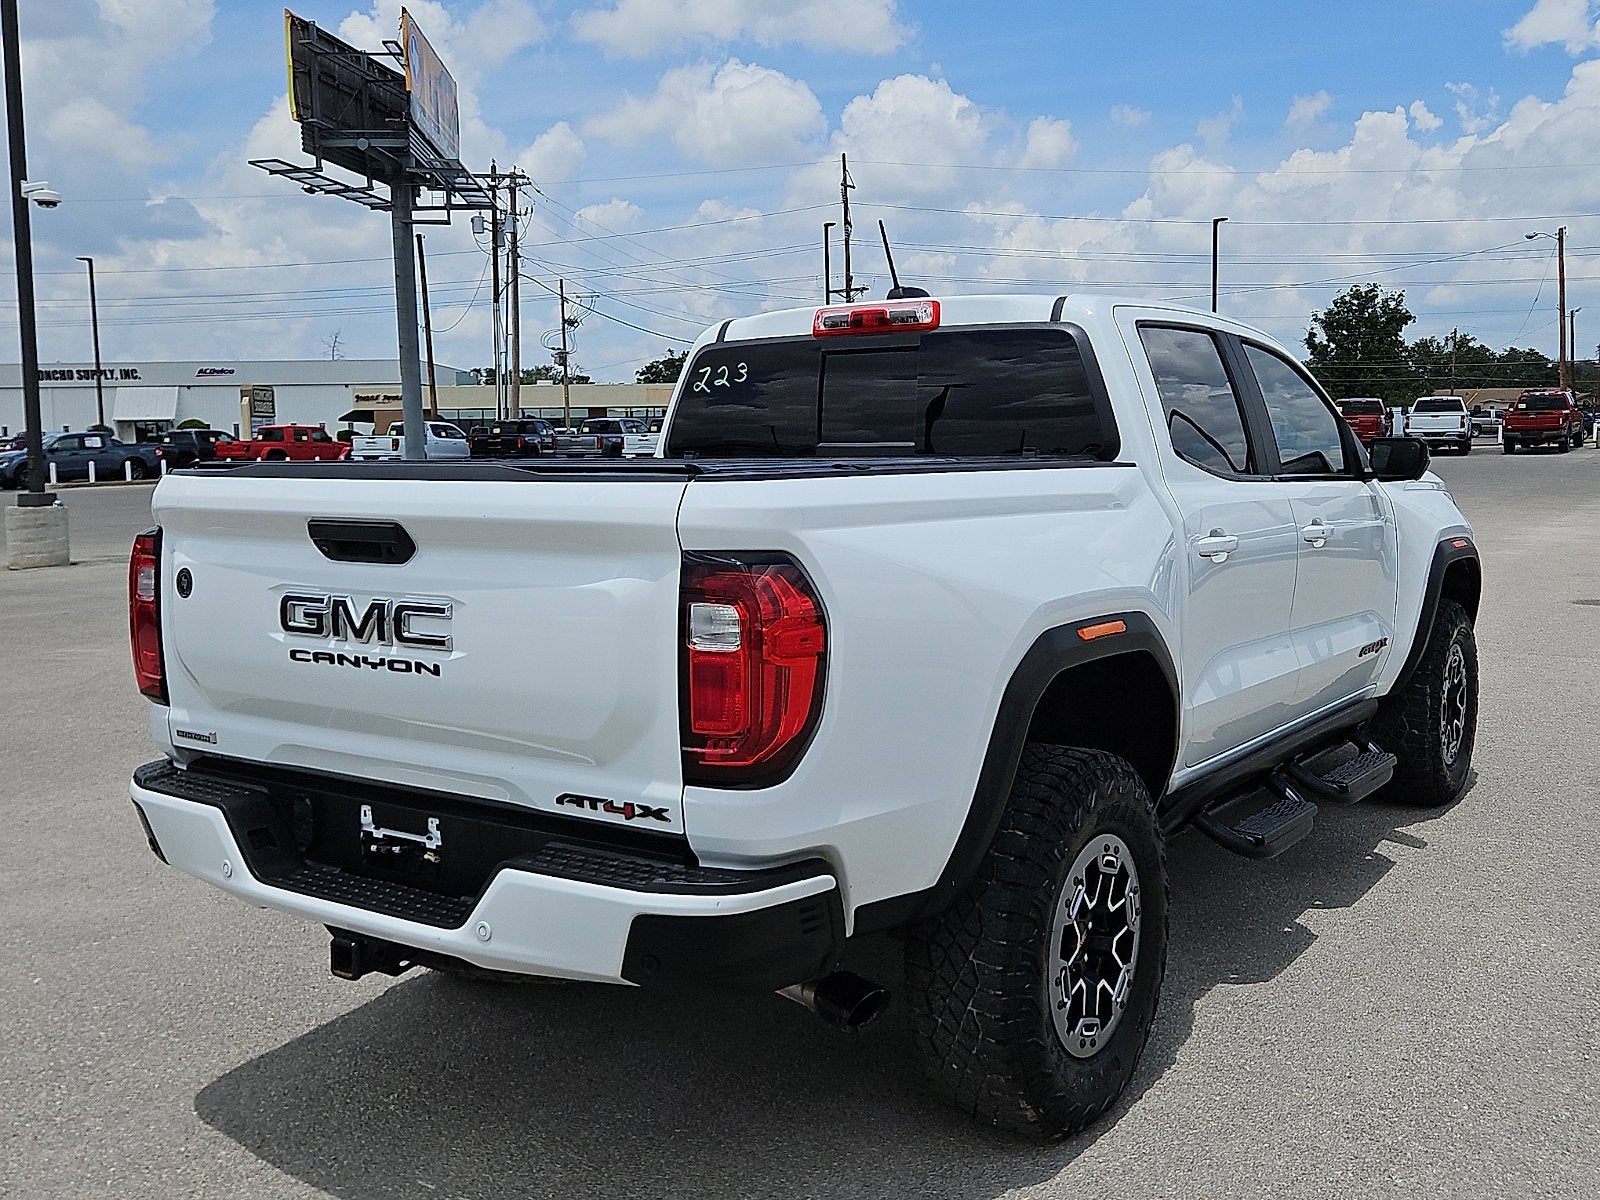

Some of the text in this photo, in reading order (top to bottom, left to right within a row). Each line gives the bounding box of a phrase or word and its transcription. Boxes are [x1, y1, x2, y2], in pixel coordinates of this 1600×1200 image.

[38, 369, 74, 381] ONCHO
[197, 367, 235, 376] ACDelco
[692, 362, 748, 394] 223
[280, 591, 454, 653] GMC
[289, 648, 442, 678] CANYON
[555, 792, 671, 822] AT4X
